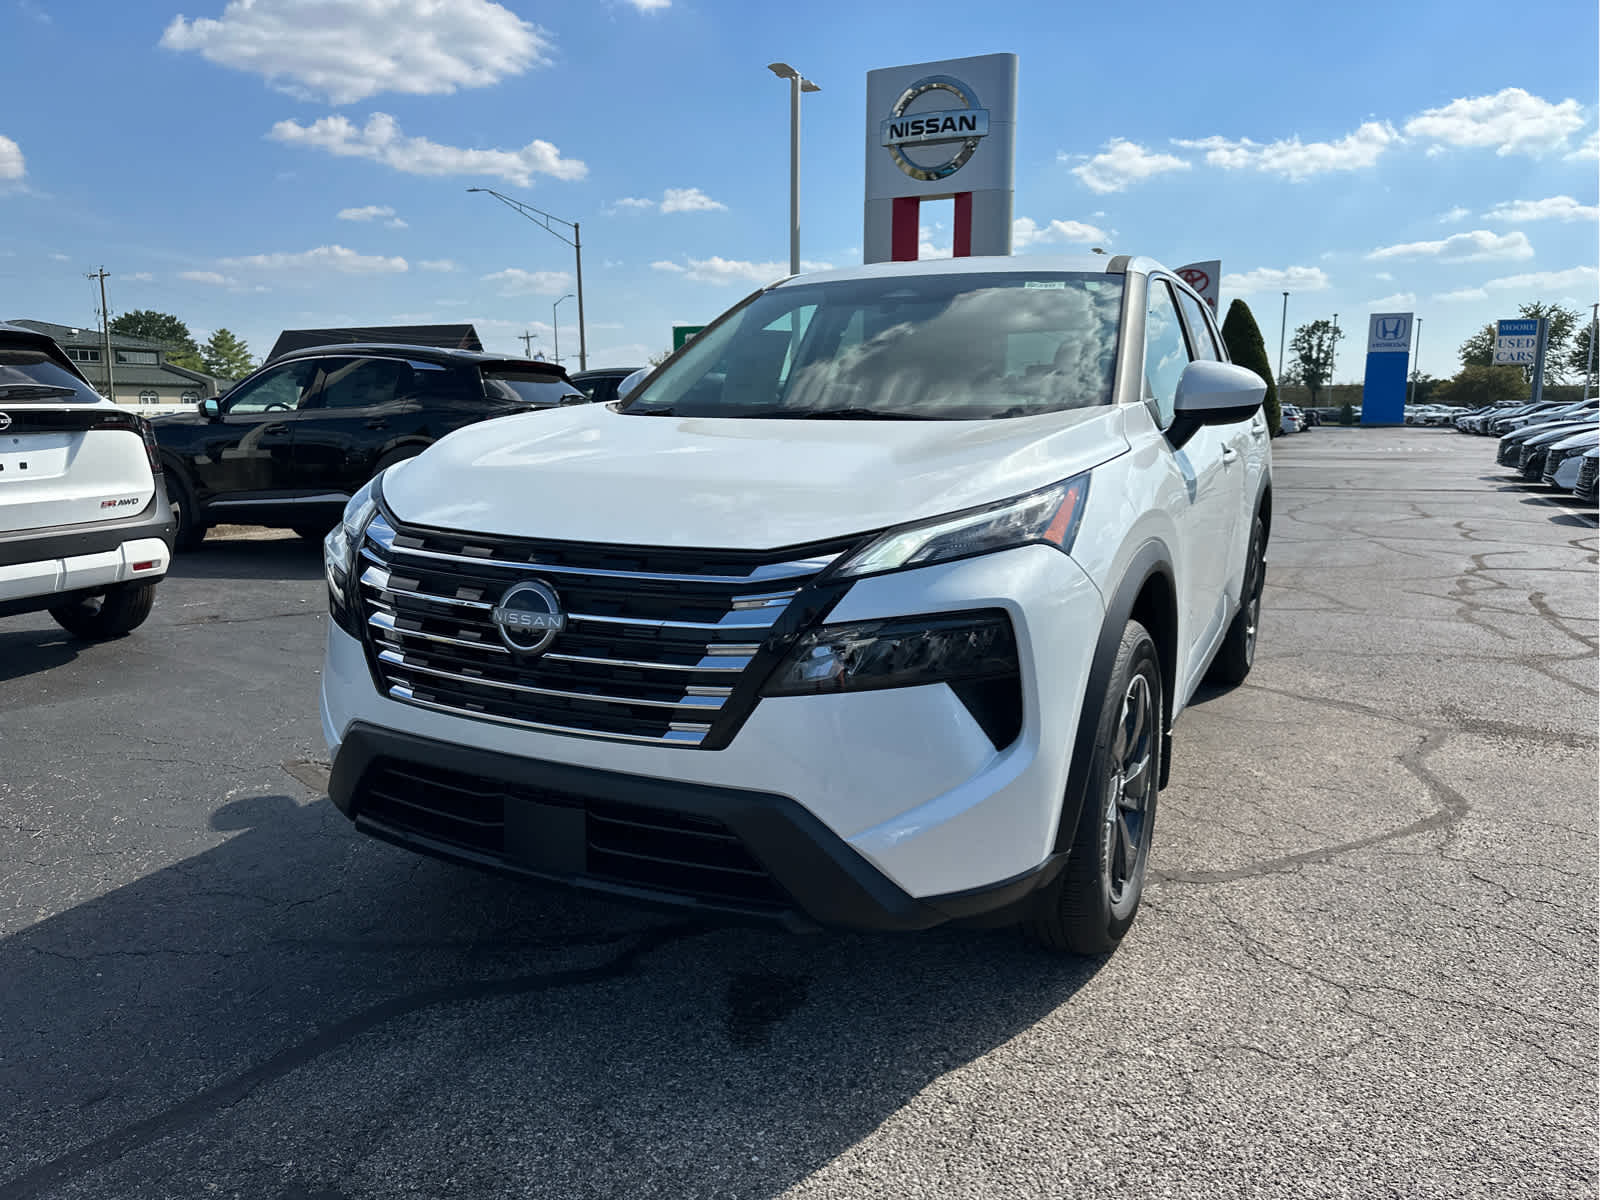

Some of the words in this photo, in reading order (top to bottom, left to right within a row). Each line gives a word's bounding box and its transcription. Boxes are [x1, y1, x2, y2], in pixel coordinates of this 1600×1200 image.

[890, 115, 976, 139] NISSAN
[1501, 323, 1536, 331] MOORE
[1498, 338, 1535, 349] USED
[1496, 351, 1535, 361] CARS
[118, 498, 138, 506] AWD
[494, 609, 561, 627] NISSAN
